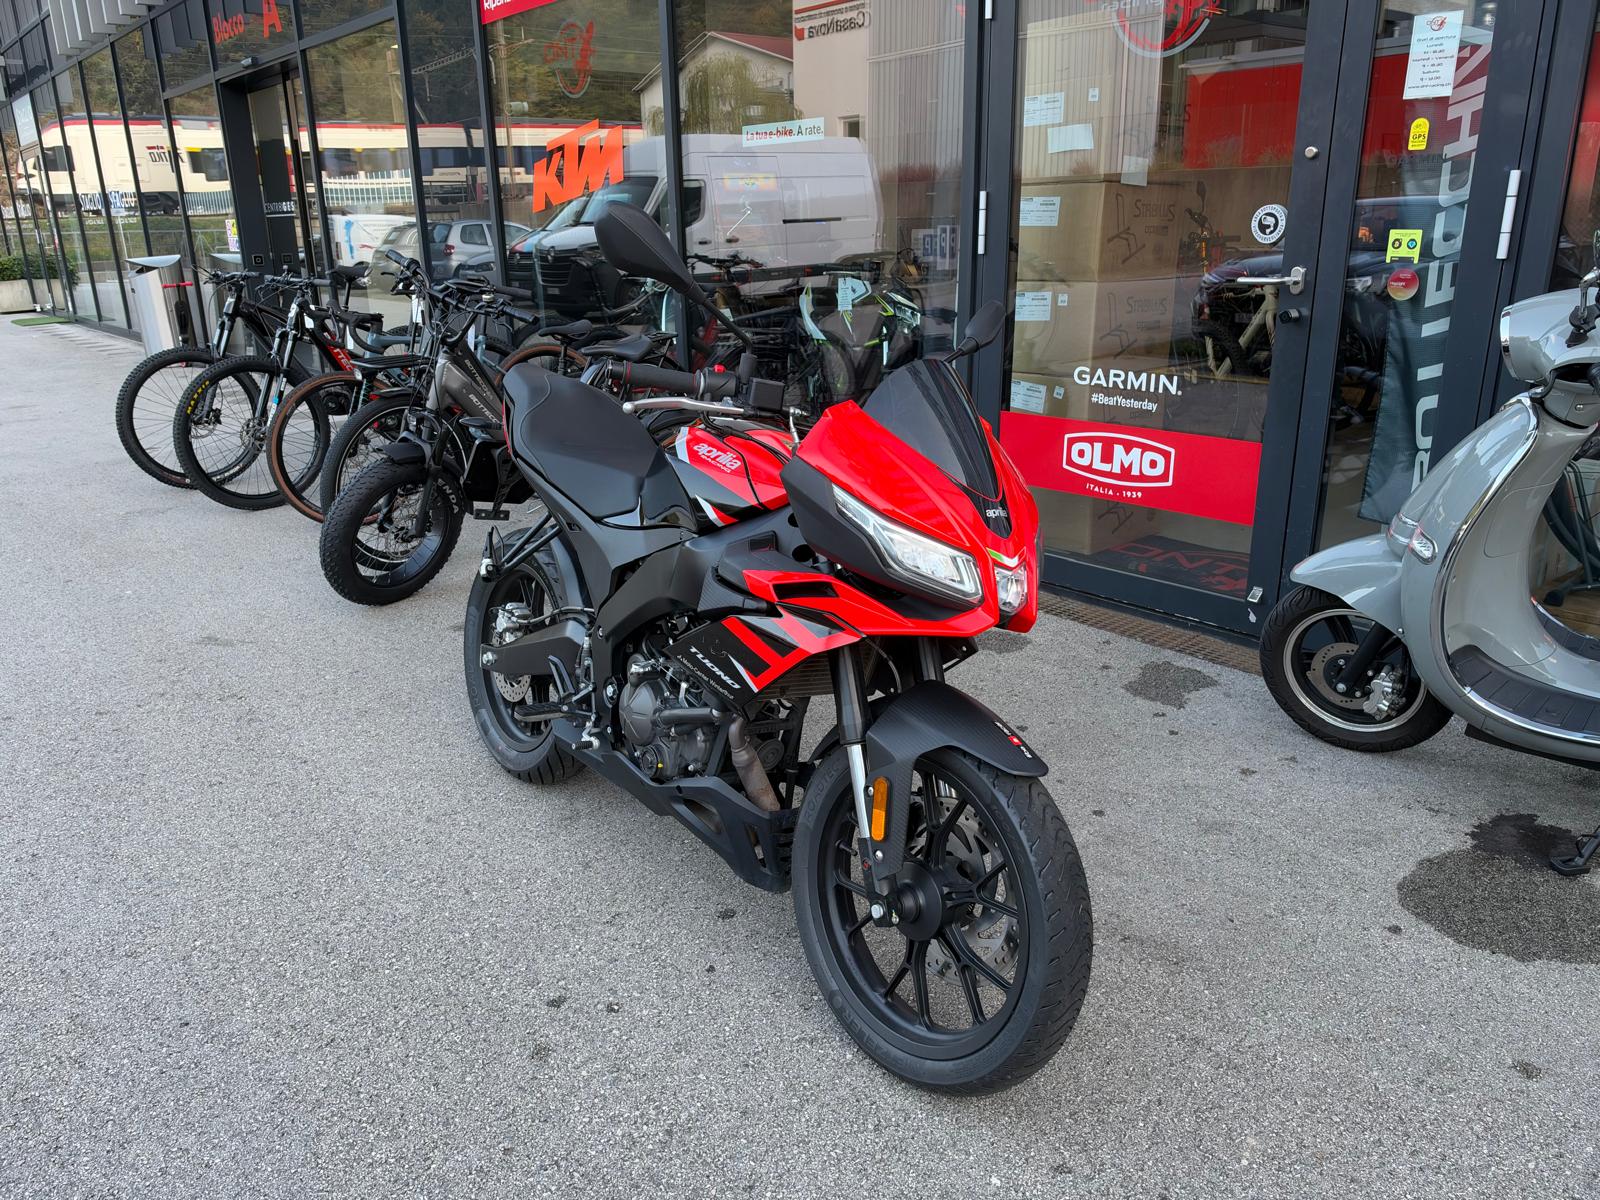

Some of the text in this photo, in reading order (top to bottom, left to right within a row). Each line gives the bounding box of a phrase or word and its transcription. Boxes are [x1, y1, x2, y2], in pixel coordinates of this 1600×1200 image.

[212, 0, 283, 45] Blocco A
[797, 125, 804, 137] A
[804, 124, 824, 137] rate.
[532, 118, 624, 214] KTM
[1091, 392, 1158, 413] #BeatYesterday
[693, 443, 742, 470] aprilia
[1070, 441, 1166, 477] OLMO
[437, 478, 460, 514] ENDA
[1086, 483, 1143, 499] ITALIA 1939
[689, 645, 742, 689] TUONO
